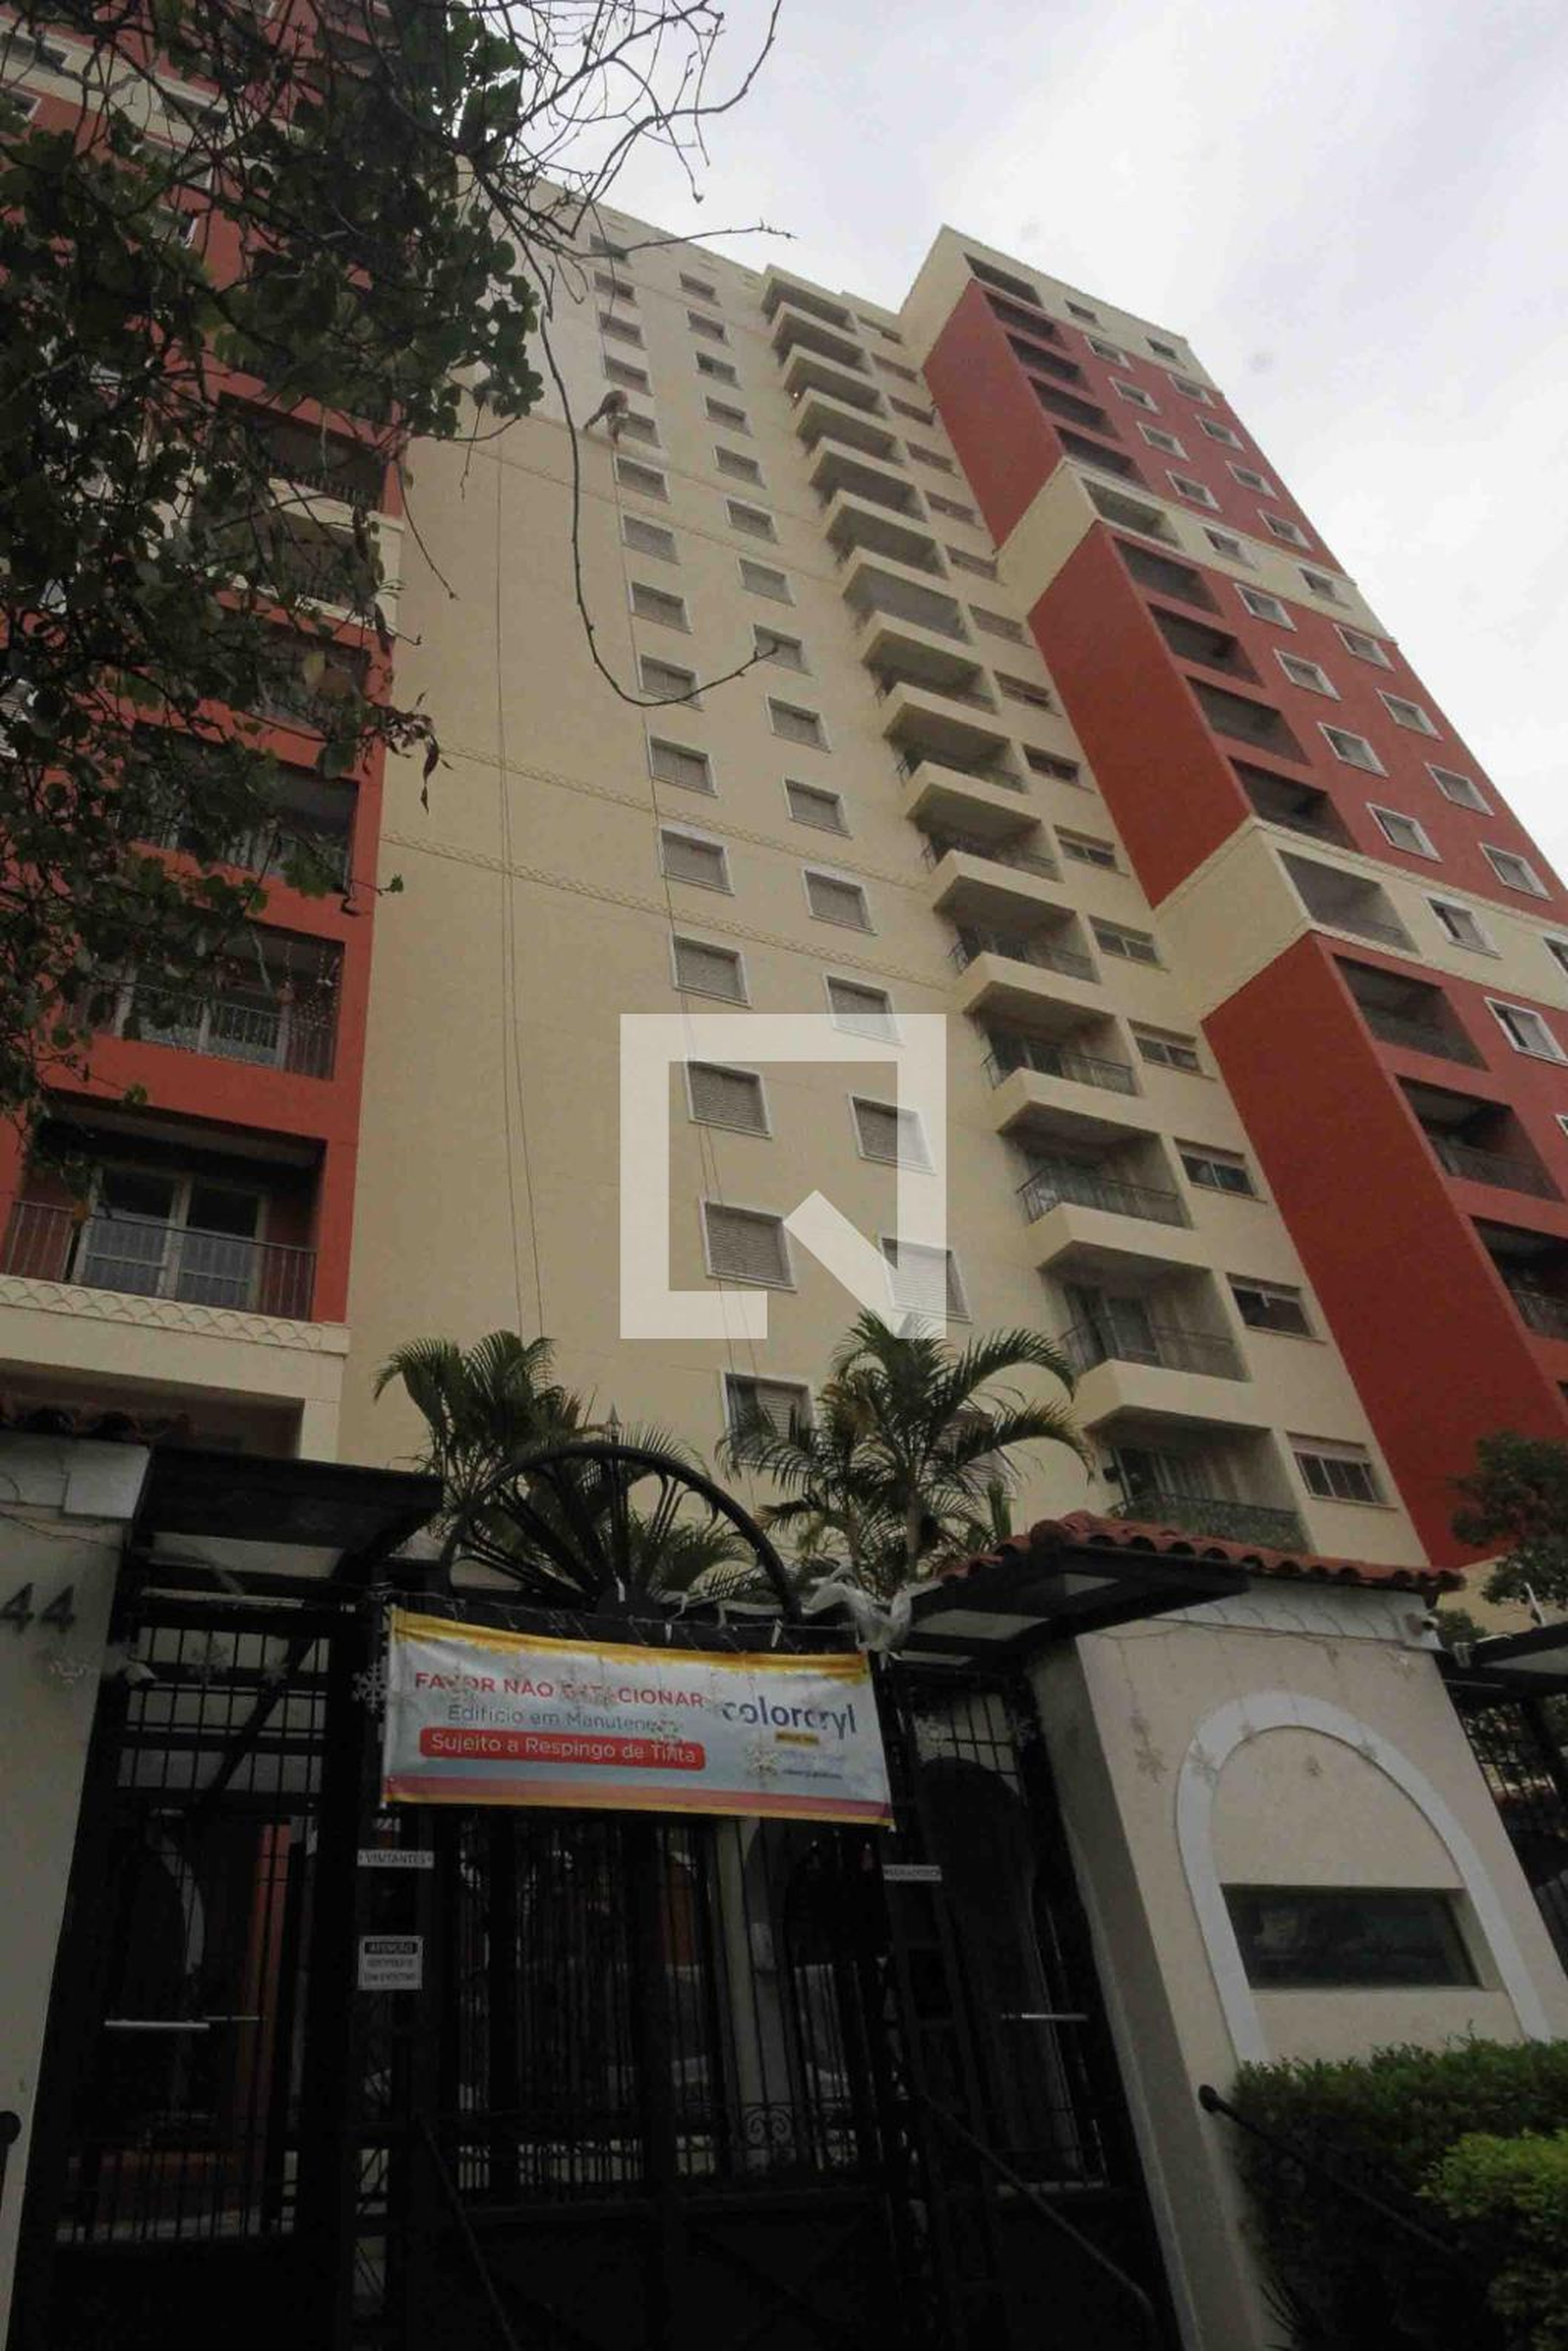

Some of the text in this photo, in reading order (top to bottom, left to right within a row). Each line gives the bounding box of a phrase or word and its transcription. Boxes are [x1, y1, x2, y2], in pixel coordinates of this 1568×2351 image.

[530, 1713, 560, 1726] em
[431, 1733, 696, 1763] Sujeito a Respingo de Tinta
